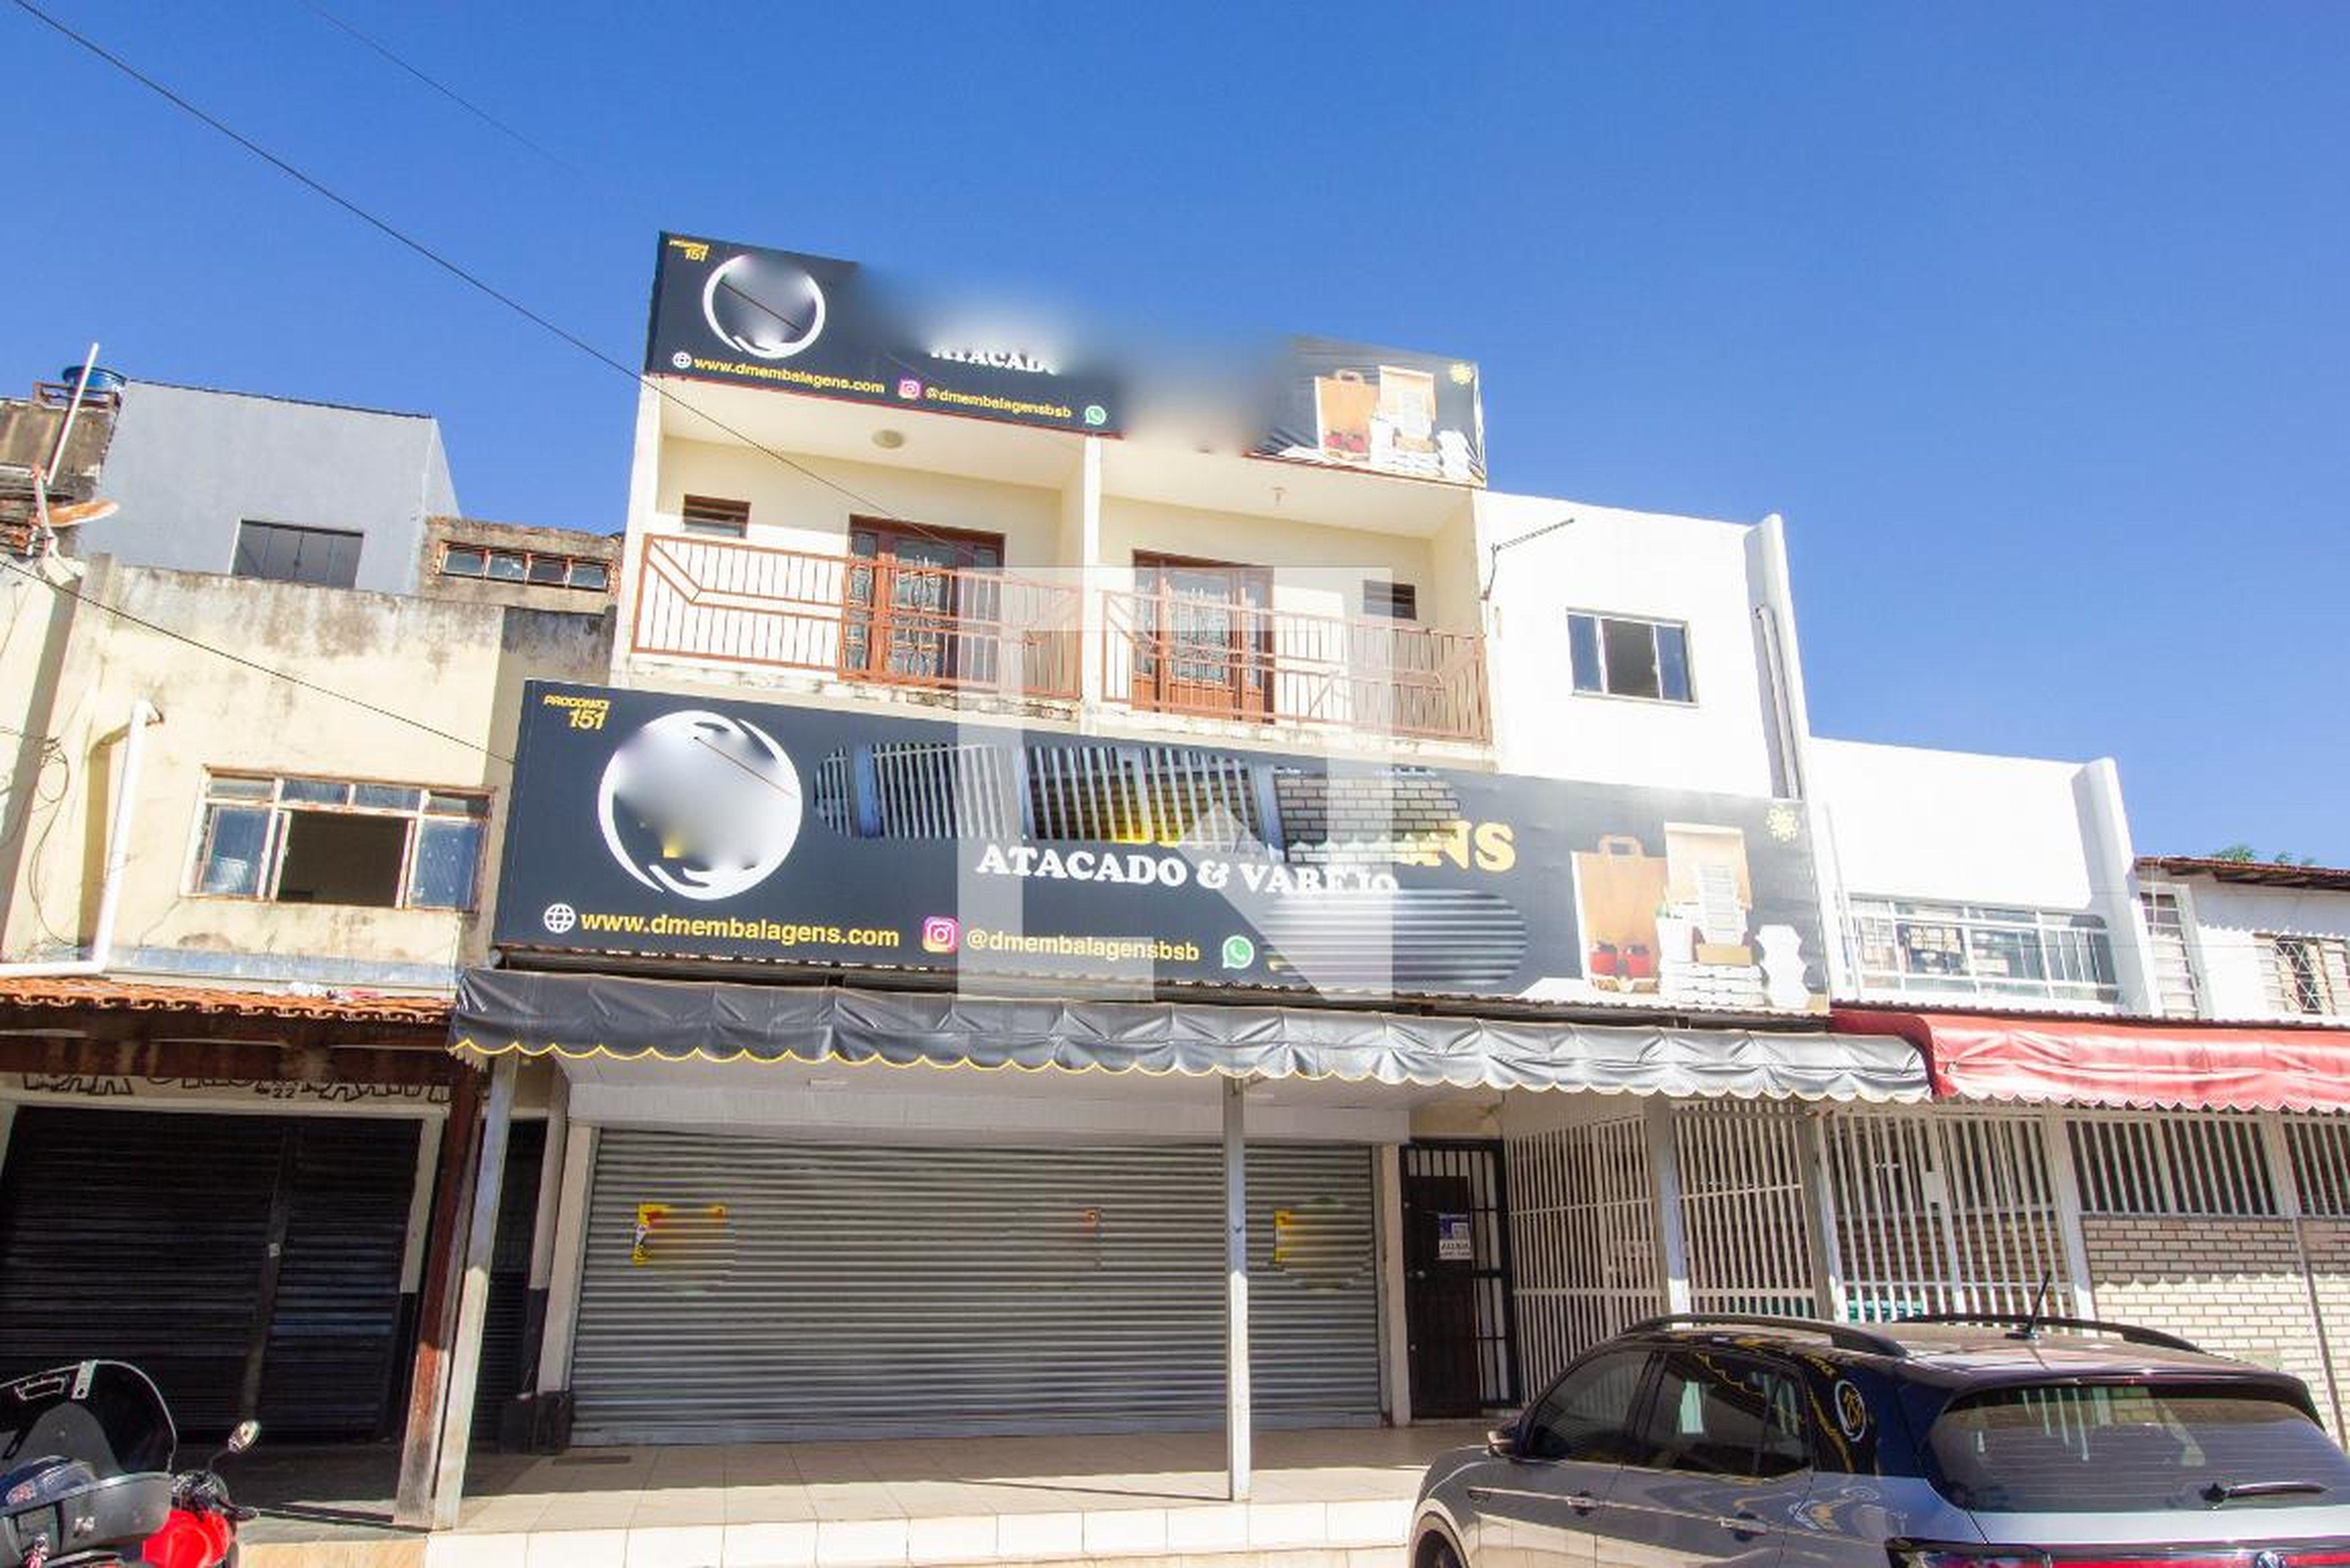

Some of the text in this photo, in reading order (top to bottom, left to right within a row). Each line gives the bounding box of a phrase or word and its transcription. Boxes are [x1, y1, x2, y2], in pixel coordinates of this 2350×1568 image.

[685, 245, 709, 262] 151
[694, 359, 885, 393] www.dmembalagens.com
[925, 386, 1072, 419] @dmembalagensbsb
[569, 708, 606, 730] 151
[975, 843, 1188, 887] ATACADO
[1196, 859, 1230, 889] &
[580, 912, 900, 947] www.dmembalagens.com
[967, 929, 1200, 962] @dmembalagensbsb
